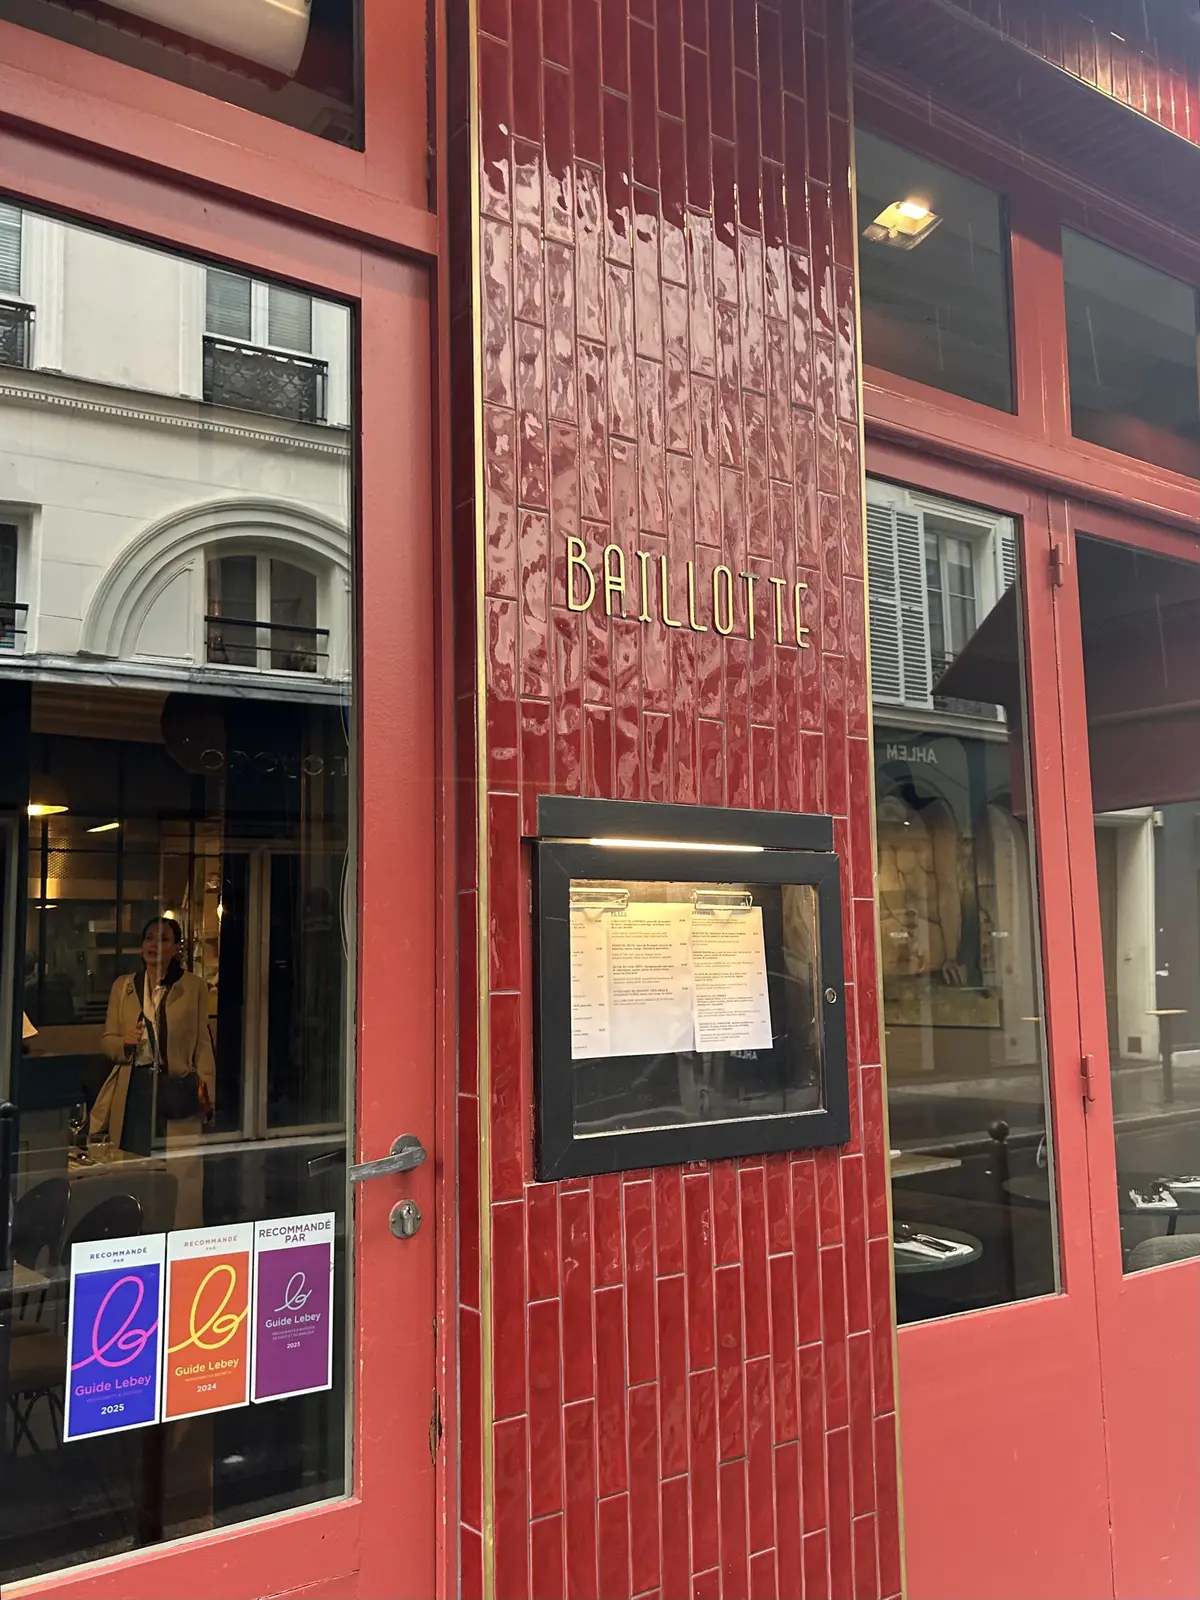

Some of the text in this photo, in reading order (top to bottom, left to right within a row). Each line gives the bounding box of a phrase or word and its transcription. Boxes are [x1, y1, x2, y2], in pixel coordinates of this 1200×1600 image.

[567, 536, 810, 648] BAILLOTTE
[259, 1219, 331, 1238] RECOMMANDÉ
[184, 1234, 238, 1247] RECOMMANDÉ
[285, 1233, 306, 1243] PAR
[90, 1246, 148, 1259] RECOMMANDÉ
[265, 1313, 321, 1328] Guide Lebey
[175, 1363, 206, 1376] Guide
[208, 1358, 239, 1370] Lebey
[75, 1381, 111, 1396] Guide
[115, 1375, 151, 1389] Lebey
[196, 1383, 217, 1393] 2024
[101, 1403, 125, 1415] 2025
